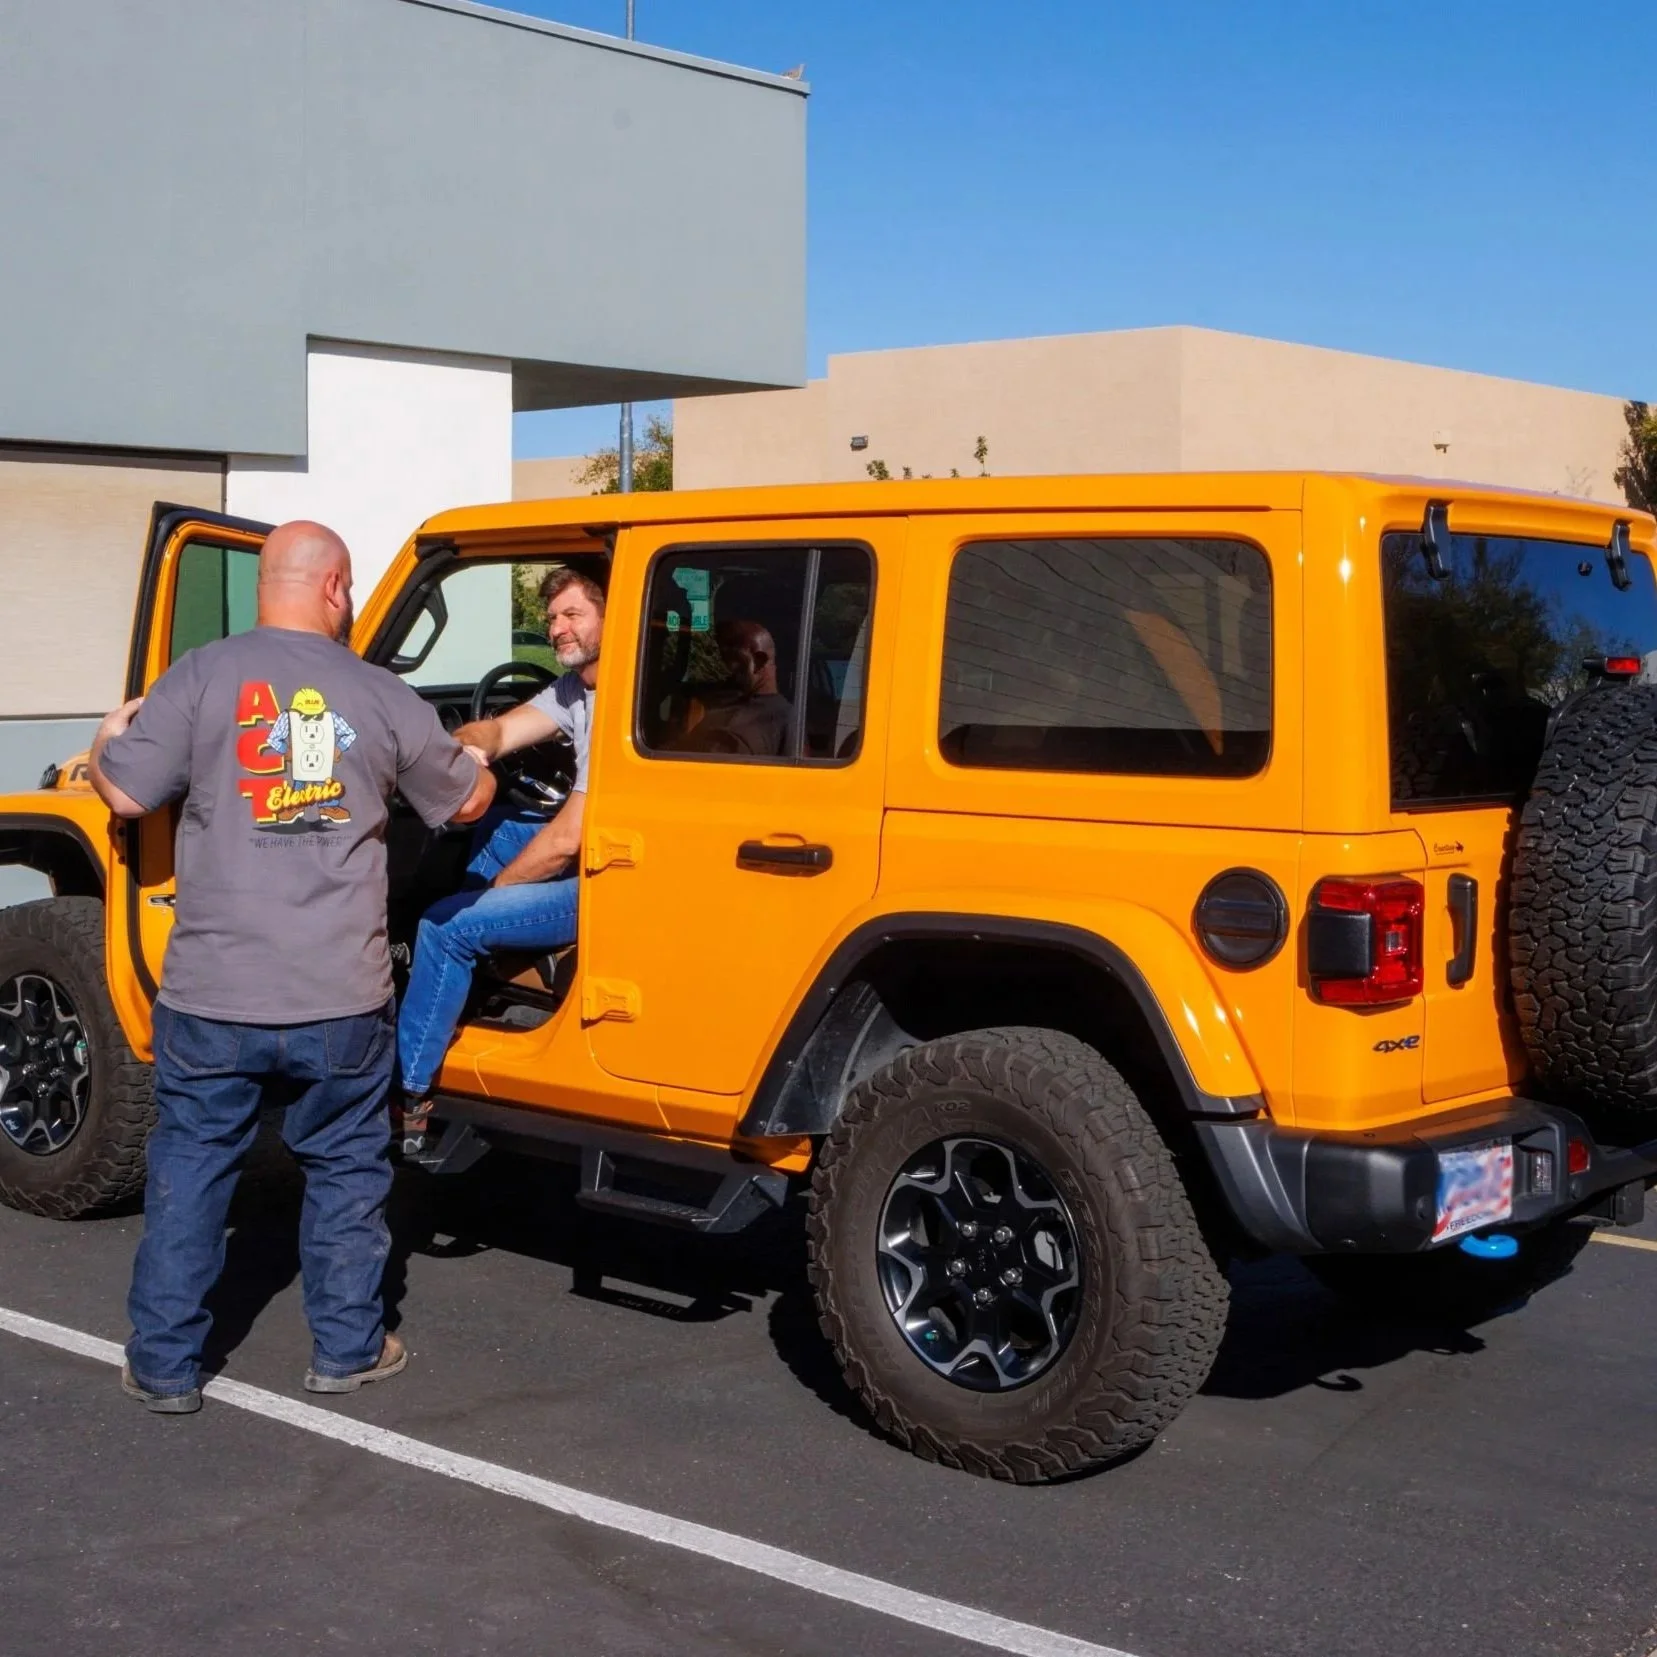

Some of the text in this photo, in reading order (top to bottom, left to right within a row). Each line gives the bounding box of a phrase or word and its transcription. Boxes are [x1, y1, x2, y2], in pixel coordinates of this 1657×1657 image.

[266, 778, 344, 811] Electric
[270, 836, 295, 848] HAVE
[297, 835, 315, 847] THE
[933, 1102, 971, 1113] KO2
